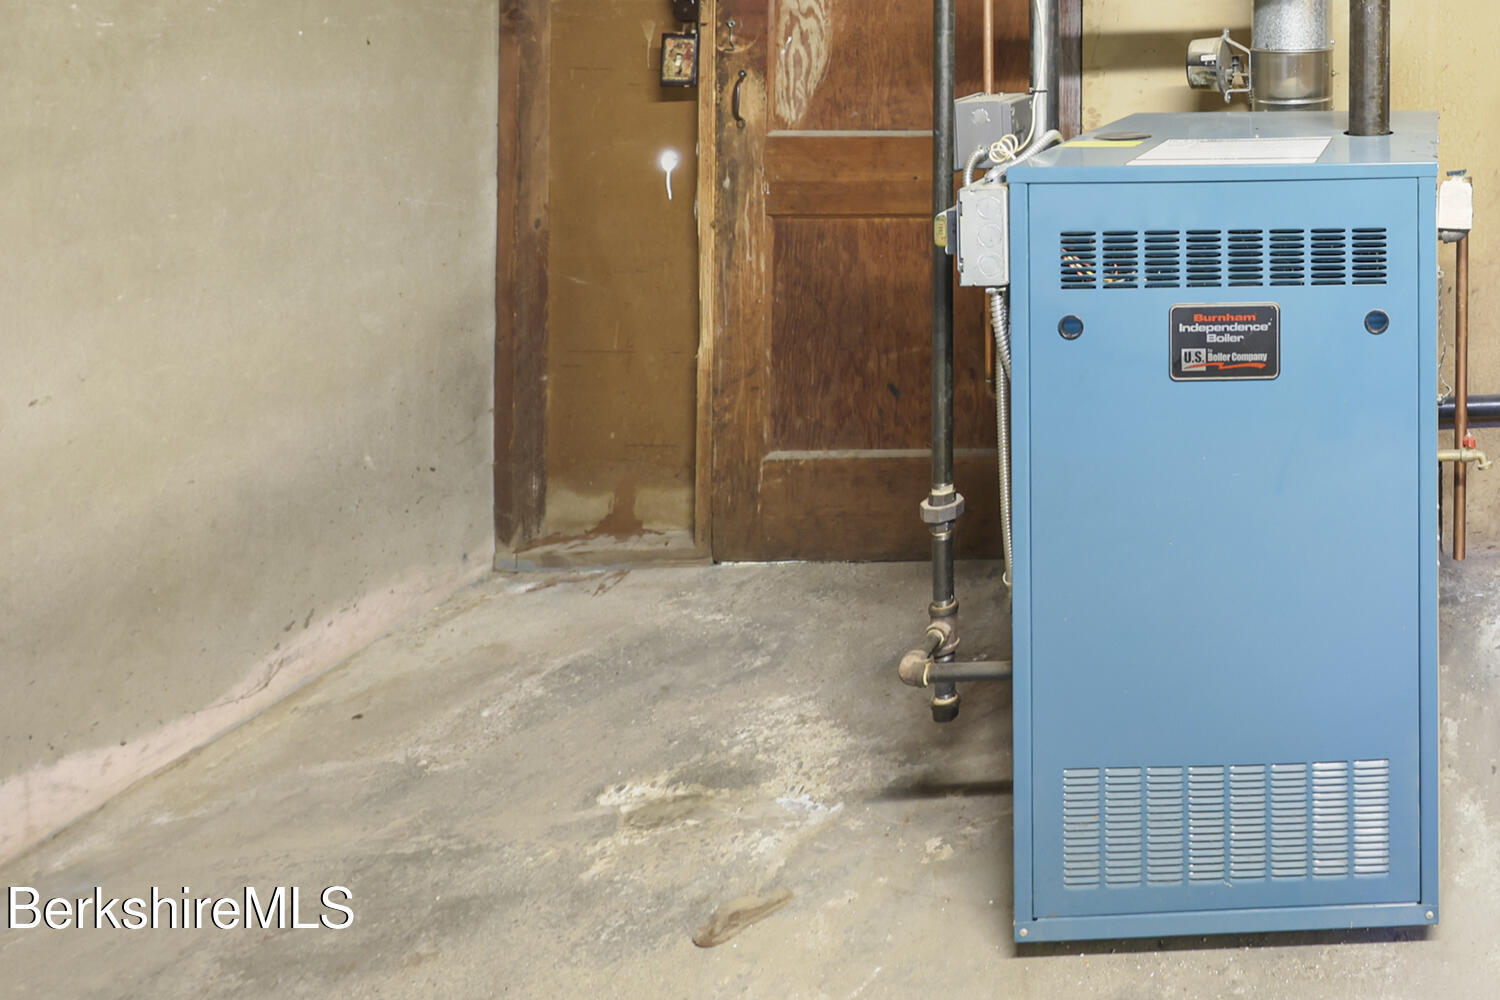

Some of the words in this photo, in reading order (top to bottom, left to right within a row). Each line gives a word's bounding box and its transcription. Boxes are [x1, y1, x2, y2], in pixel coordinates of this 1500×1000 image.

[1193, 314, 1256, 322] Burnham
[1206, 333, 1245, 343] Boiler
[1183, 350, 1205, 363] U.S.
[1207, 351, 1231, 362] Boiler
[1231, 351, 1268, 362] Company
